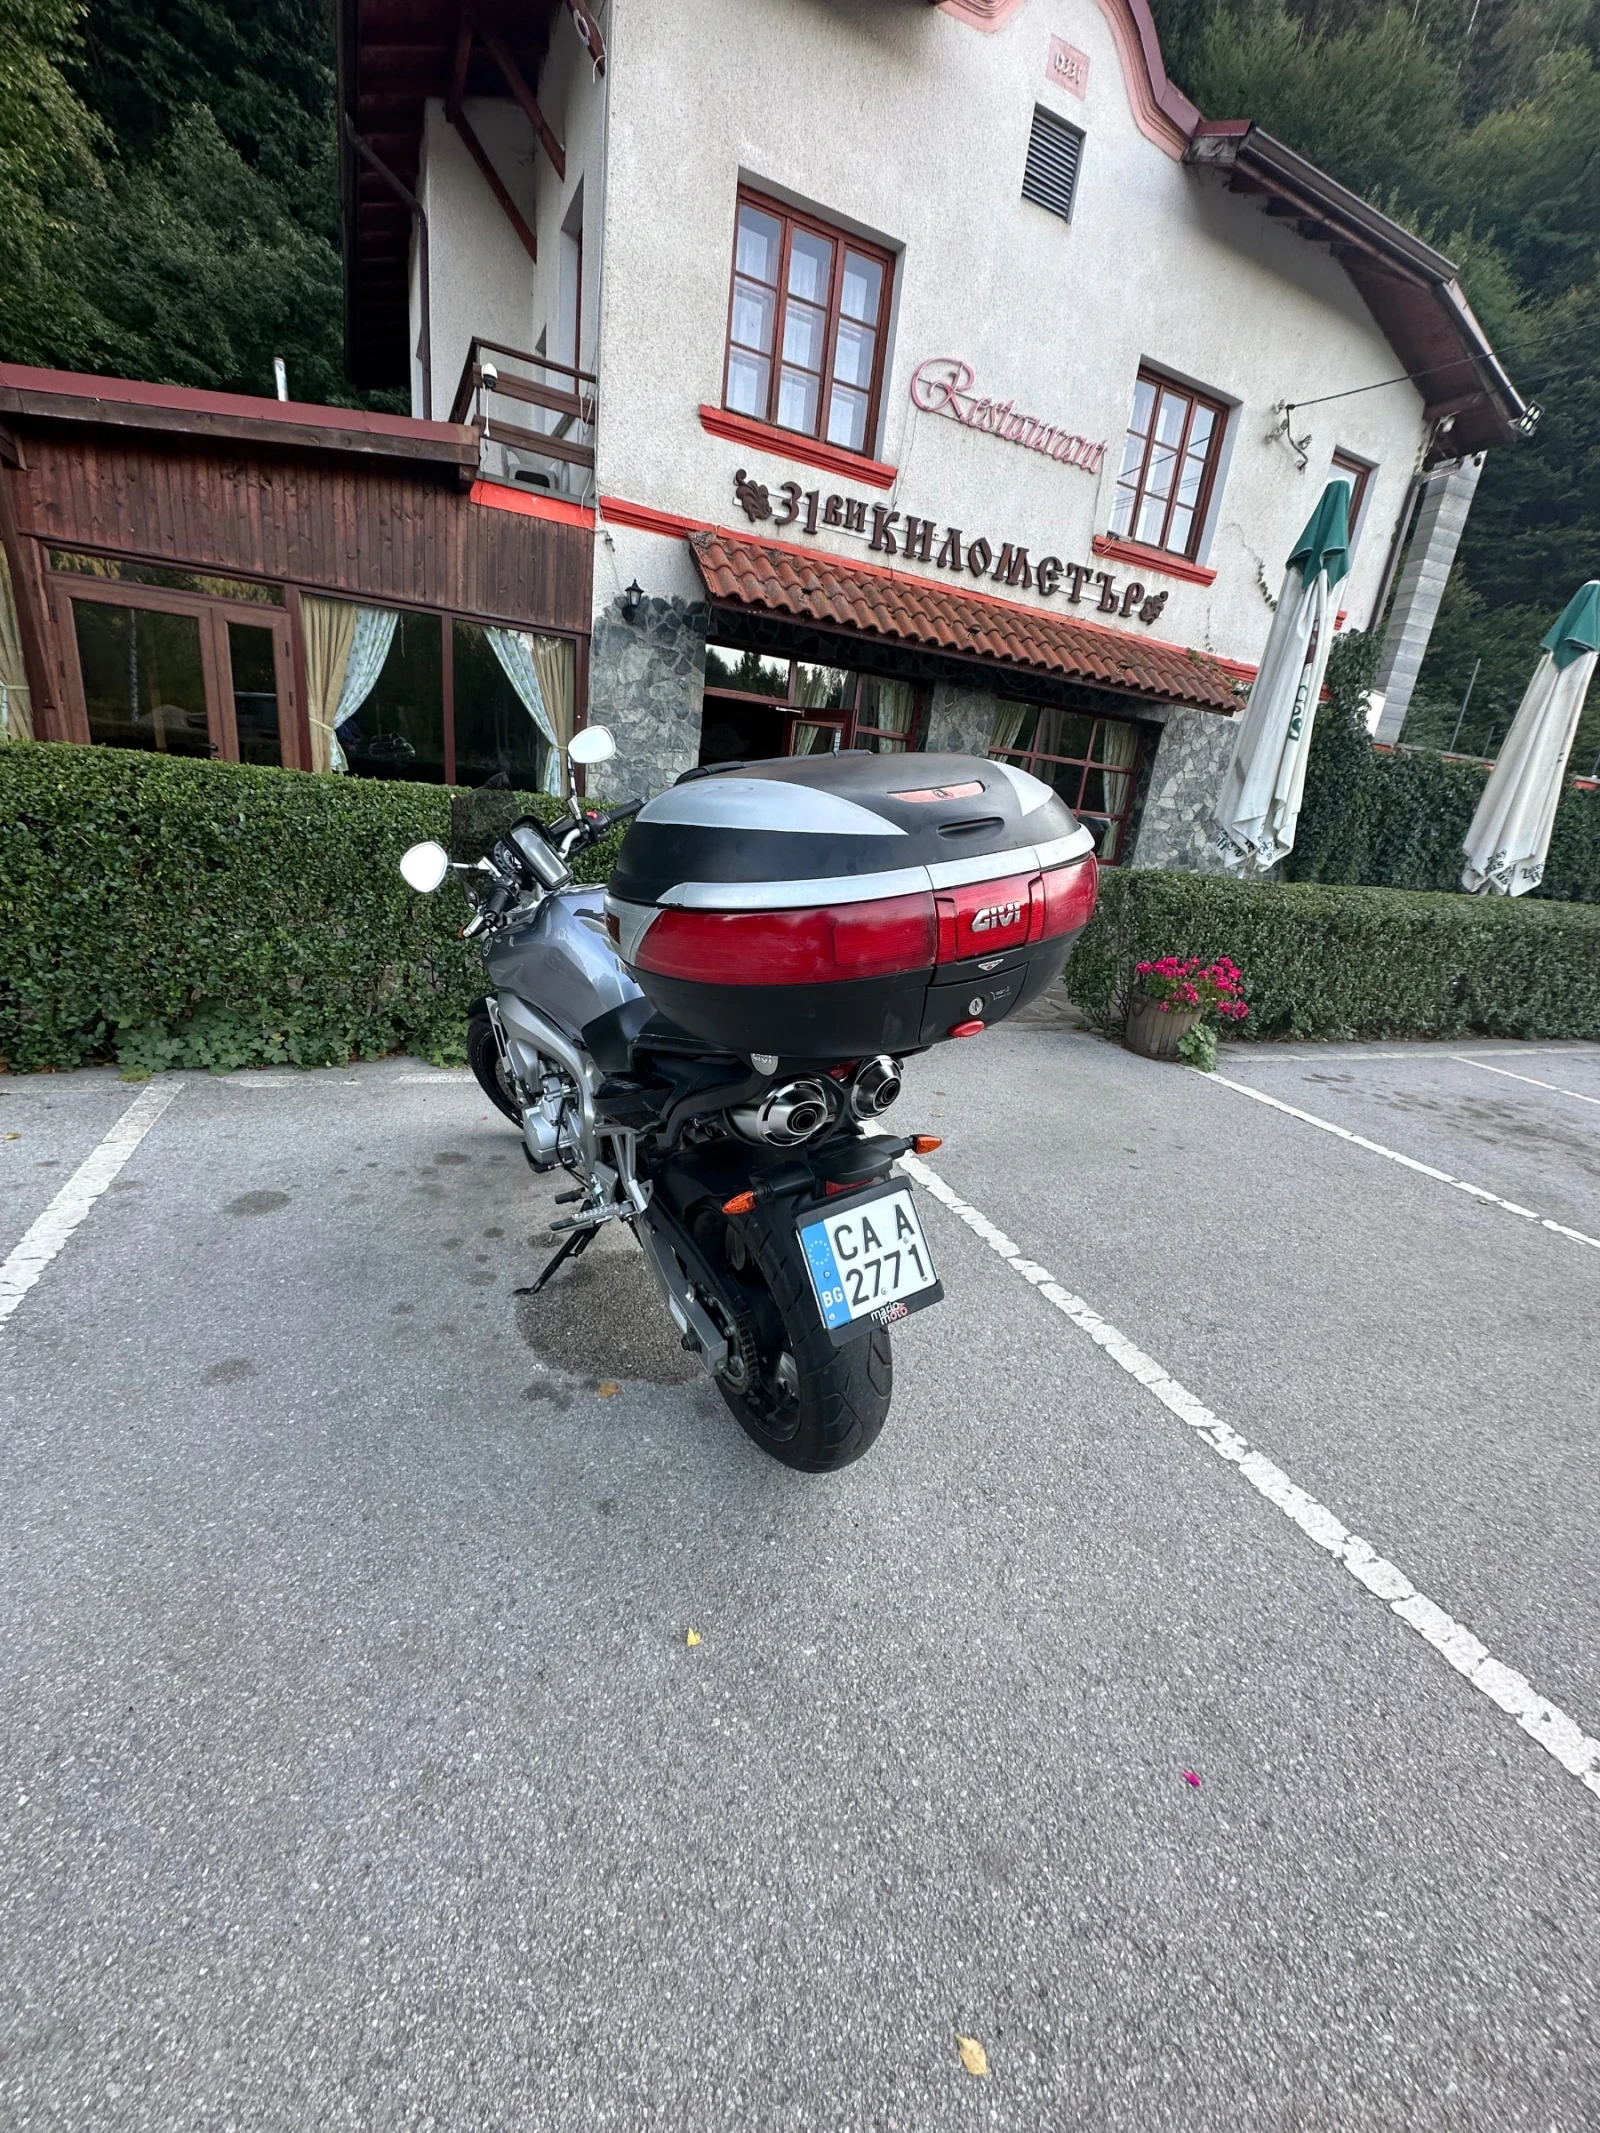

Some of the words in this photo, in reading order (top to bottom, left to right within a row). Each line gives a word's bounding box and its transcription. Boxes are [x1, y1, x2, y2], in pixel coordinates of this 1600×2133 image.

[911, 357, 1109, 474] Restaurant
[971, 901, 1021, 933] GIVI
[833, 1216, 883, 1261] CA
[894, 1203, 916, 1241] A
[845, 1243, 926, 1307] 2771
[821, 1286, 844, 1309] BG
[870, 1300, 901, 1322] mario
[879, 1305, 908, 1326] moto
